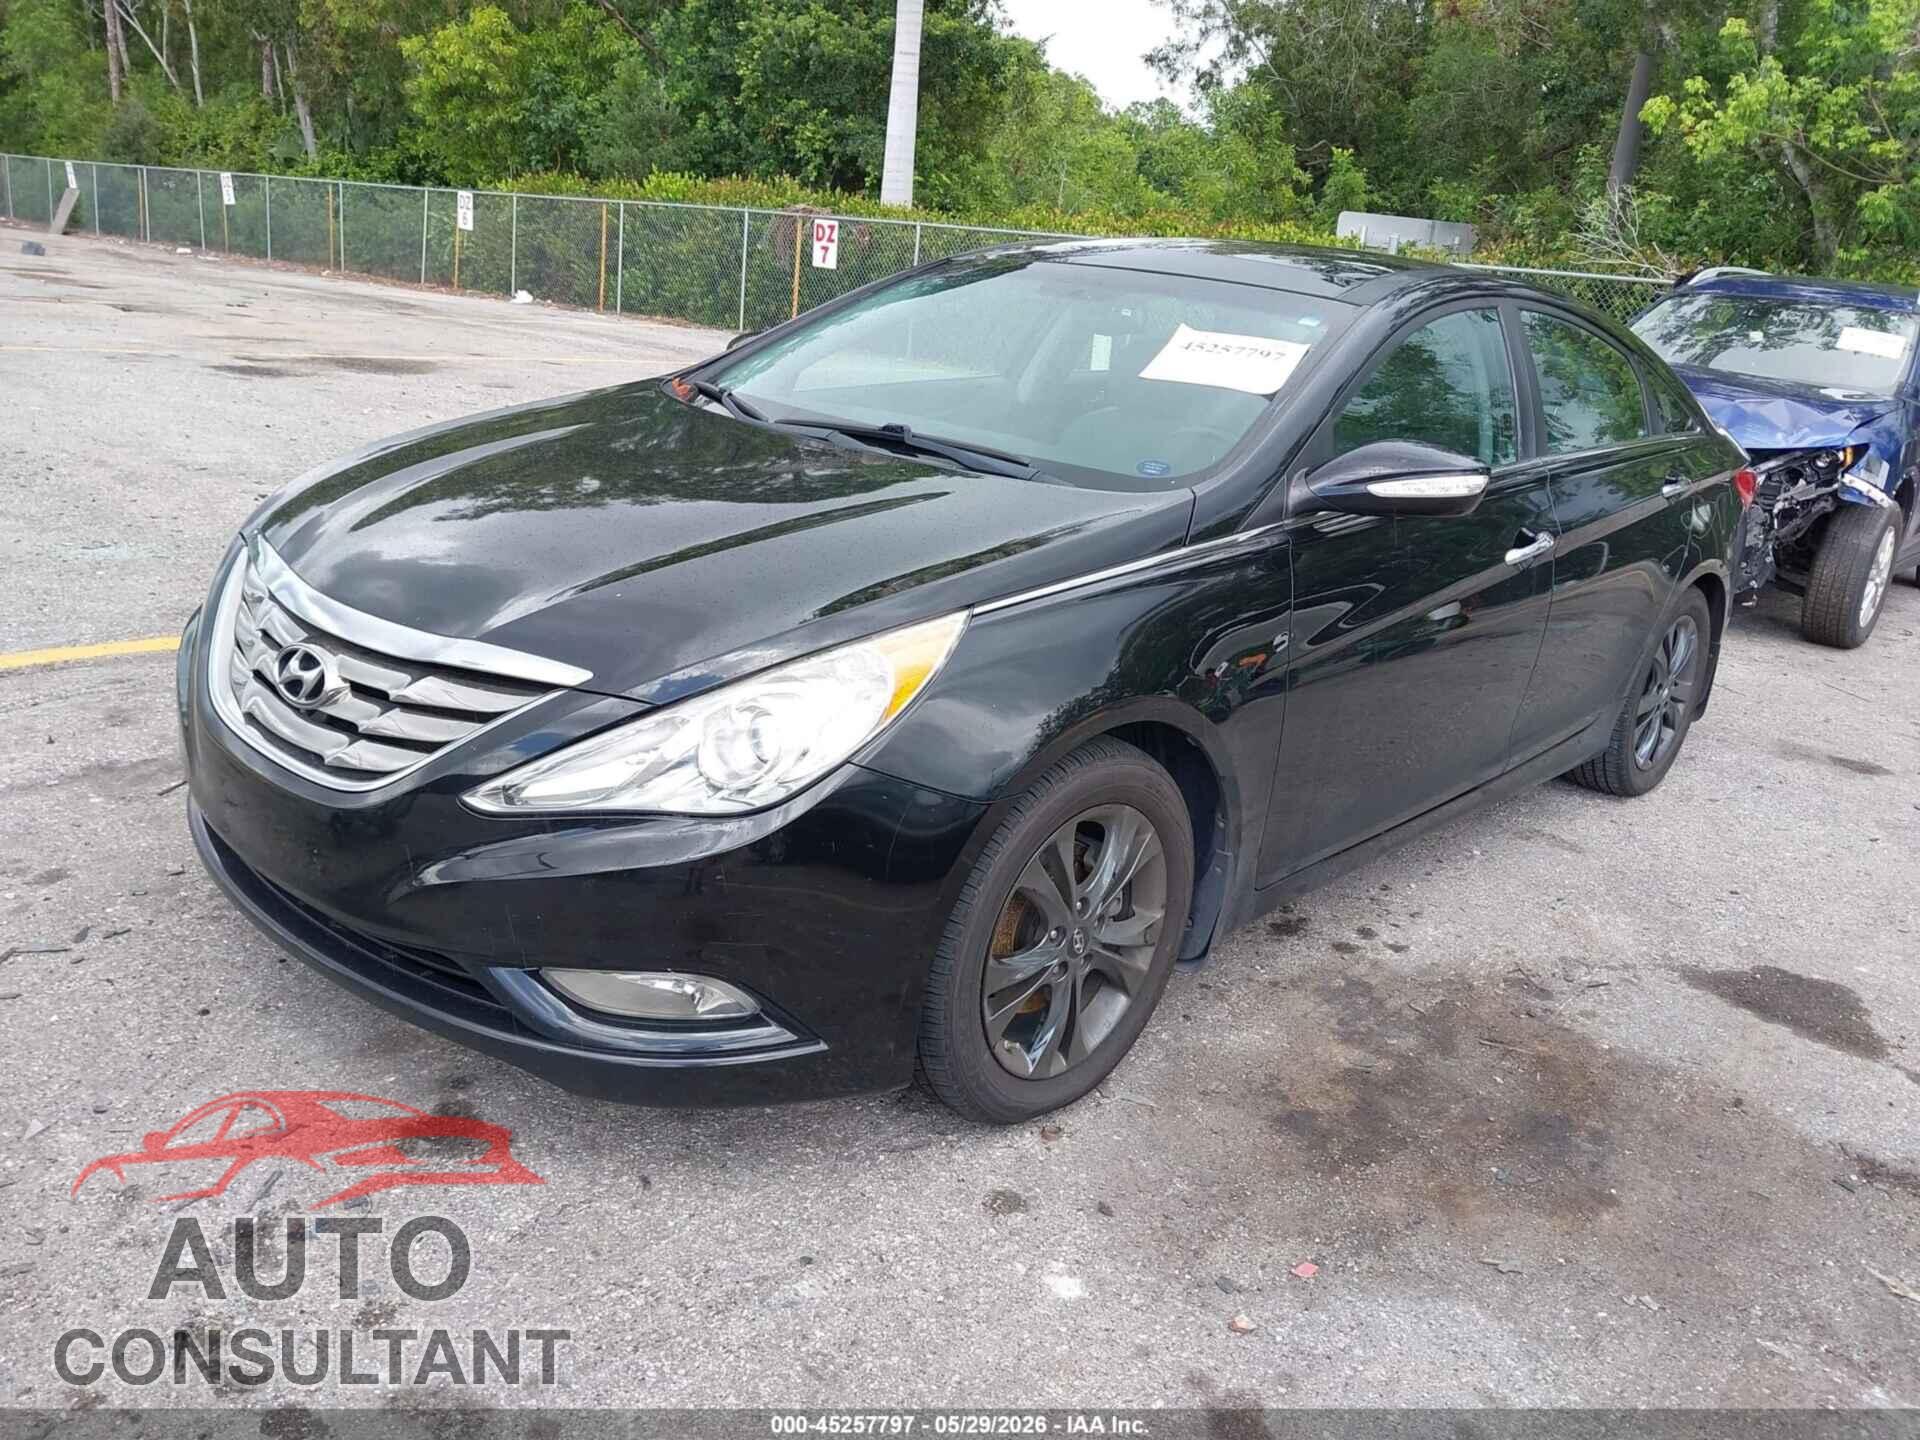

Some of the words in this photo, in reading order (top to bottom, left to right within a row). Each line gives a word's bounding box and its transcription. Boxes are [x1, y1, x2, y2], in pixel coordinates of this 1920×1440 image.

[459, 194, 471, 210] DZ
[462, 211, 468, 226] 6
[816, 223, 836, 243] DZ
[820, 246, 830, 264] 7
[1179, 341, 1287, 361] 45257797
